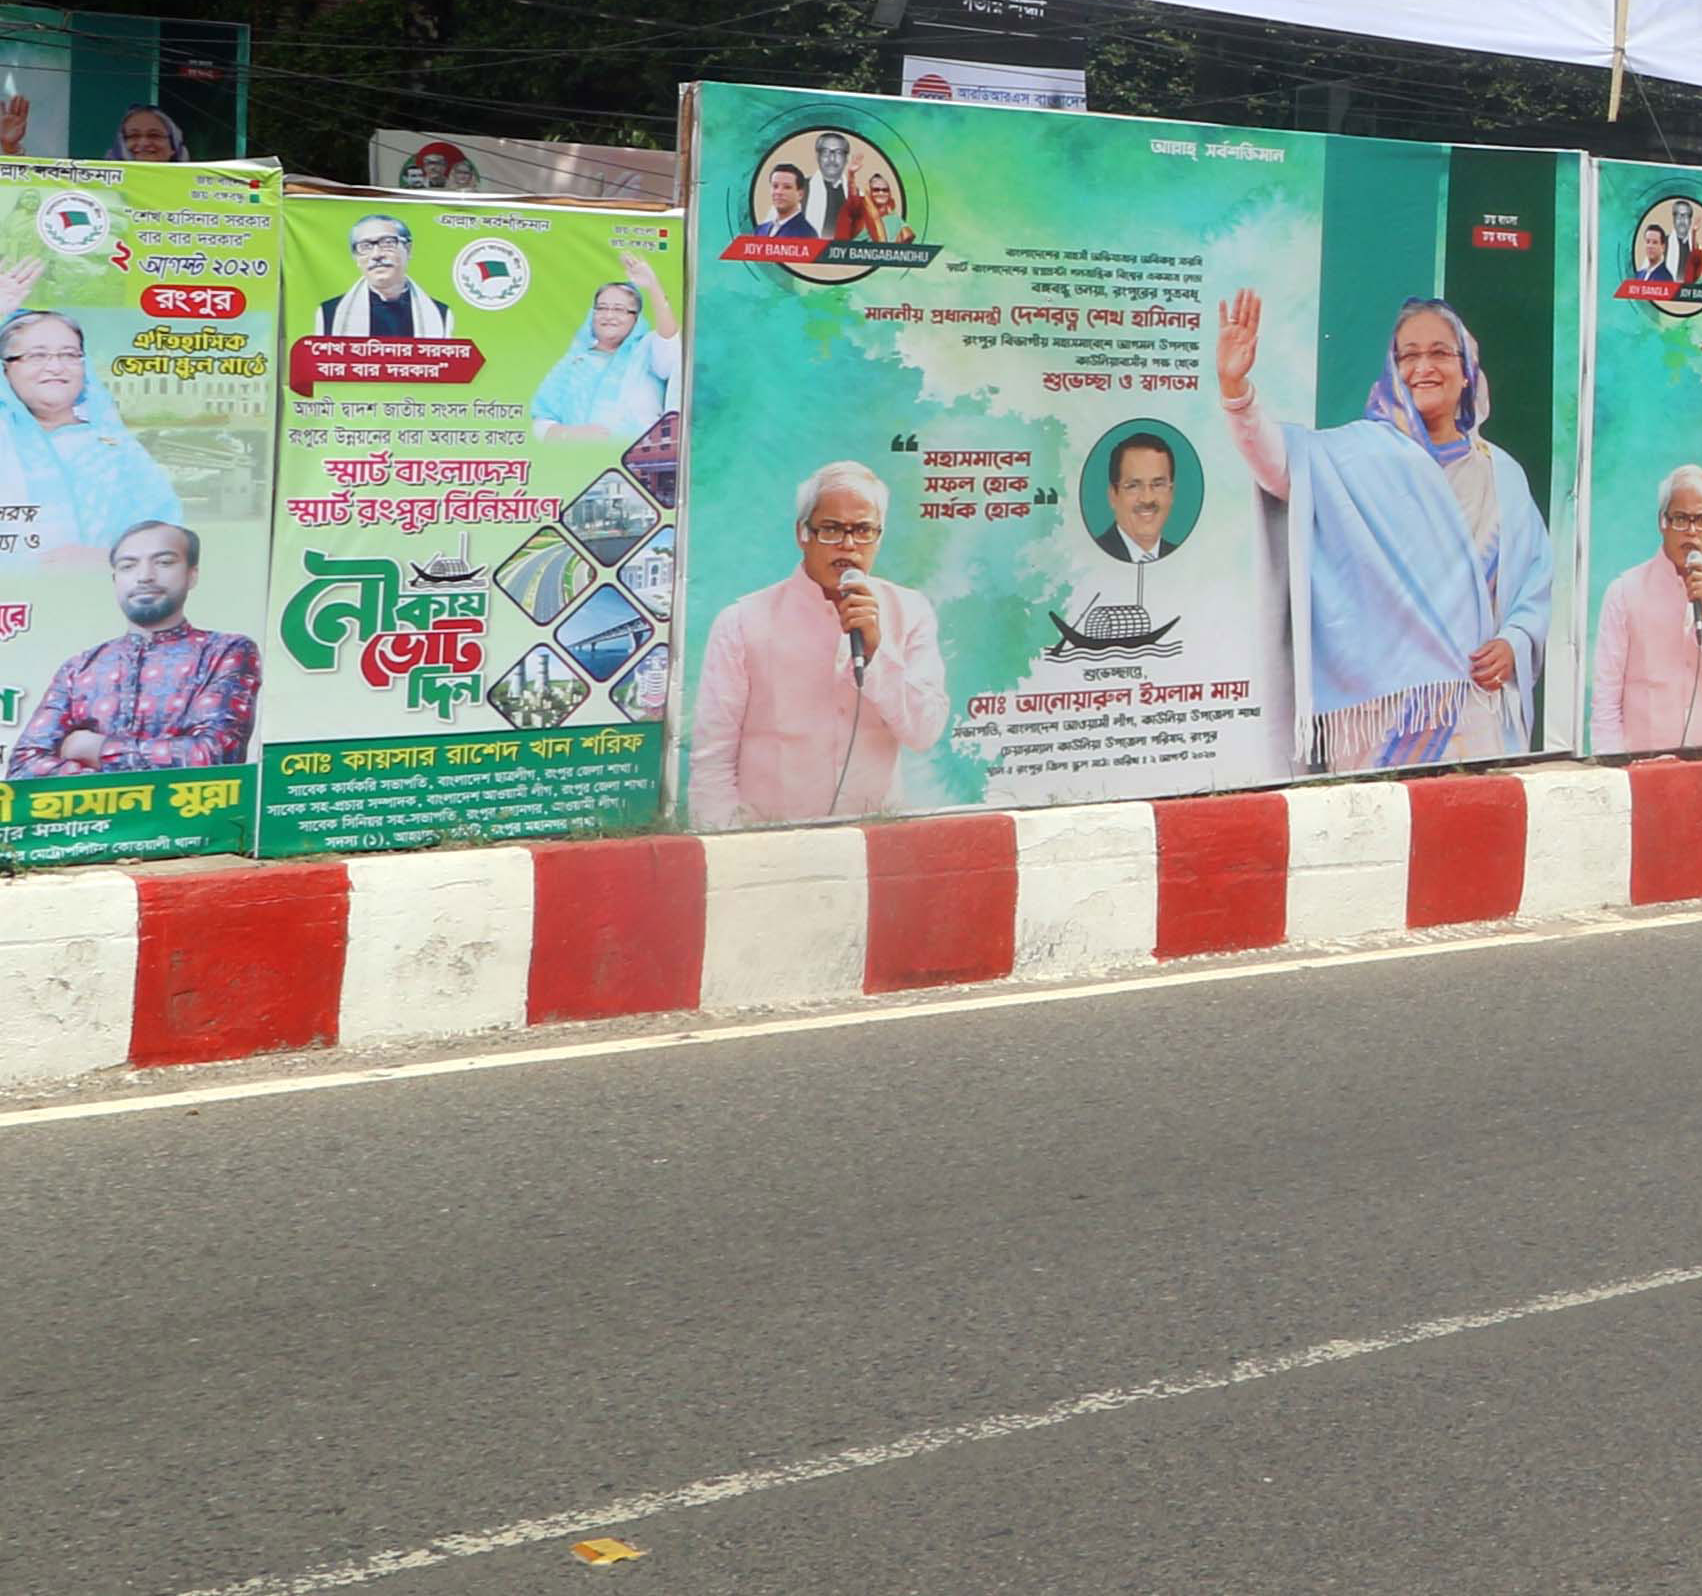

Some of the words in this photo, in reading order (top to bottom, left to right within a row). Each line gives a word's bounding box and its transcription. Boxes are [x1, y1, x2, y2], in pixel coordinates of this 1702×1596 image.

[0, 162, 30, 181] ল্লাহ
[166, 209, 219, 227] হাসিনার
[224, 215, 271, 228] সরকার
[138, 231, 162, 245] বার
[169, 233, 192, 246] বার
[744, 243, 762, 256] JOY
[766, 244, 810, 258] BANGLA
[111, 240, 132, 271] ২
[212, 257, 269, 276] ২০২৩
[153, 288, 235, 318] রংপুর
[864, 303, 923, 323] মাননীয়
[931, 305, 1001, 324] প্রধানমন্ত্রী
[1010, 305, 1080, 331] দেশরত্ন
[1087, 308, 1124, 328] শেখ
[1131, 305, 1200, 330] হাসিনার
[133, 325, 248, 352] ঐতিহাসিক
[350, 338, 412, 359] হাসিনার
[417, 344, 471, 359] সরকার
[112, 354, 170, 376] জেলা
[174, 357, 212, 380] স্কুল
[219, 353, 268, 377] মাঠে
[317, 362, 346, 378] বার
[352, 363, 380, 379] বার
[1043, 372, 1112, 392] শুভেচ্ছা
[1119, 375, 1132, 389] ও
[1140, 375, 1199, 391] স্বাগতম
[293, 398, 335, 419] আগামী
[341, 402, 377, 419] দ্বাদশ
[383, 398, 426, 420] জাতীয়
[430, 403, 468, 419] সংসদ
[472, 397, 523, 420] নির্বাচনে
[288, 427, 329, 447] রংপুরে
[334, 427, 391, 446] উন্নয়নের
[398, 429, 423, 446] ধারা
[429, 430, 481, 446] অব্যাহত
[485, 430, 526, 447] রাখতে
[323, 450, 391, 487] স্মার্ট
[394, 457, 530, 486] বাংলাদেশ
[923, 450, 1032, 470] মহাসমাবেশ
[924, 475, 975, 493] সফল
[983, 476, 1029, 496] হোক
[286, 489, 352, 526] স্মার্ট
[357, 497, 440, 534] রংপুর
[443, 489, 564, 526] বিনির্মাণে
[920, 496, 977, 520] সার্থক
[984, 502, 1030, 522] হোক
[361, 618, 484, 687] ভোট
[408, 664, 482, 720] দিন
[967, 695, 1007, 719] মোঃ
[1016, 687, 1132, 715] আনোয়ারুল
[1139, 681, 1203, 705] ইসলাম
[1210, 679, 1250, 700] মায়া
[281, 752, 331, 776] মোঃ
[342, 746, 438, 771] কায়সার
[446, 740, 520, 766] রাশেদ
[529, 737, 573, 760] খান
[581, 729, 644, 756] শরিফ
[30, 784, 155, 819] হাসান
[169, 779, 241, 818] মুন্না
[32, 819, 112, 838] সম্পাদক
